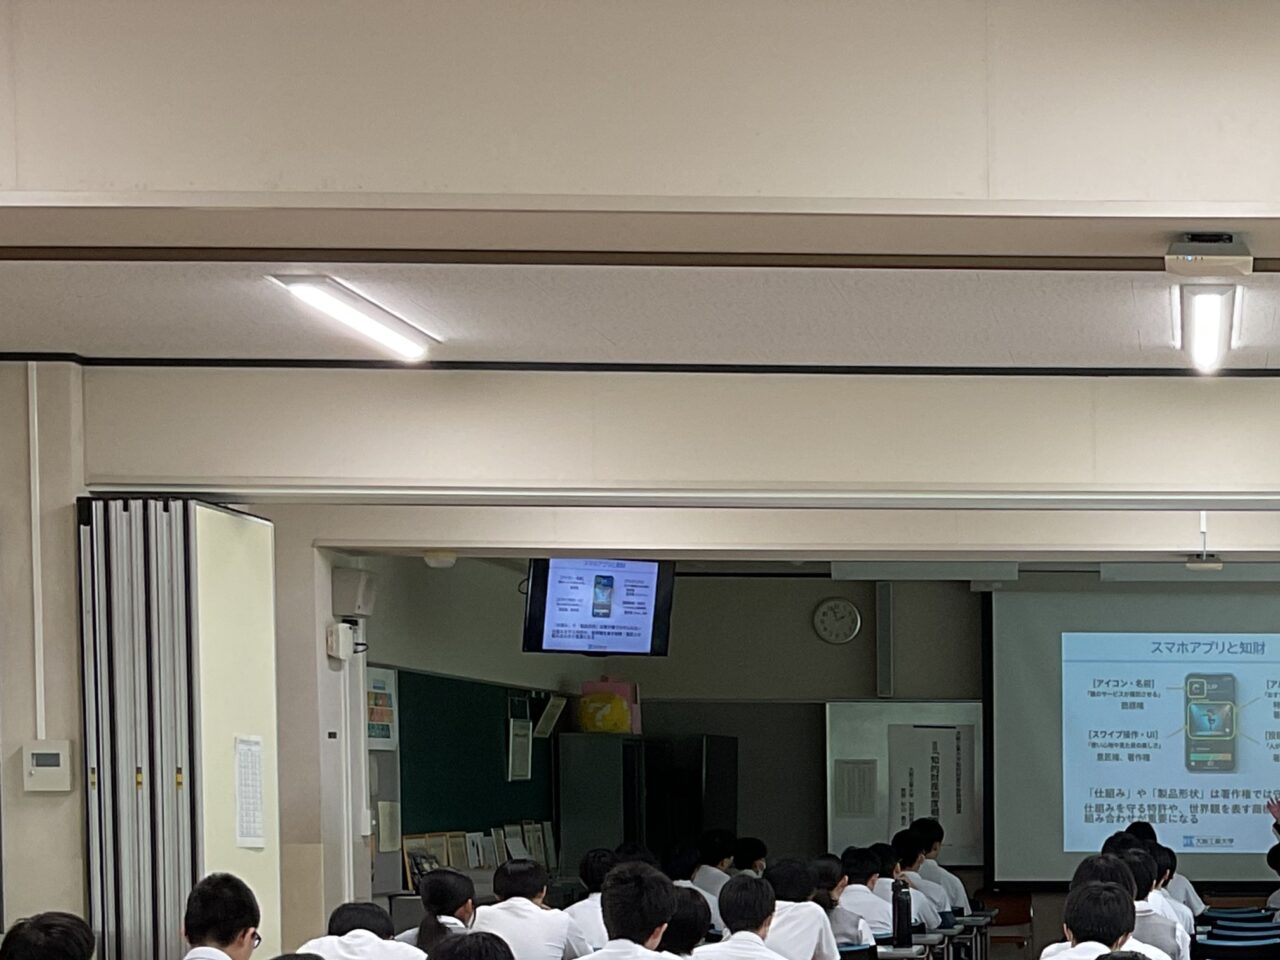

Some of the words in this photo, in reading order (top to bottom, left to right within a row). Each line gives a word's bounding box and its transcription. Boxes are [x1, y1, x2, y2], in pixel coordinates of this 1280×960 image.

[1151, 640, 1266, 655] スマホアプリと知財
